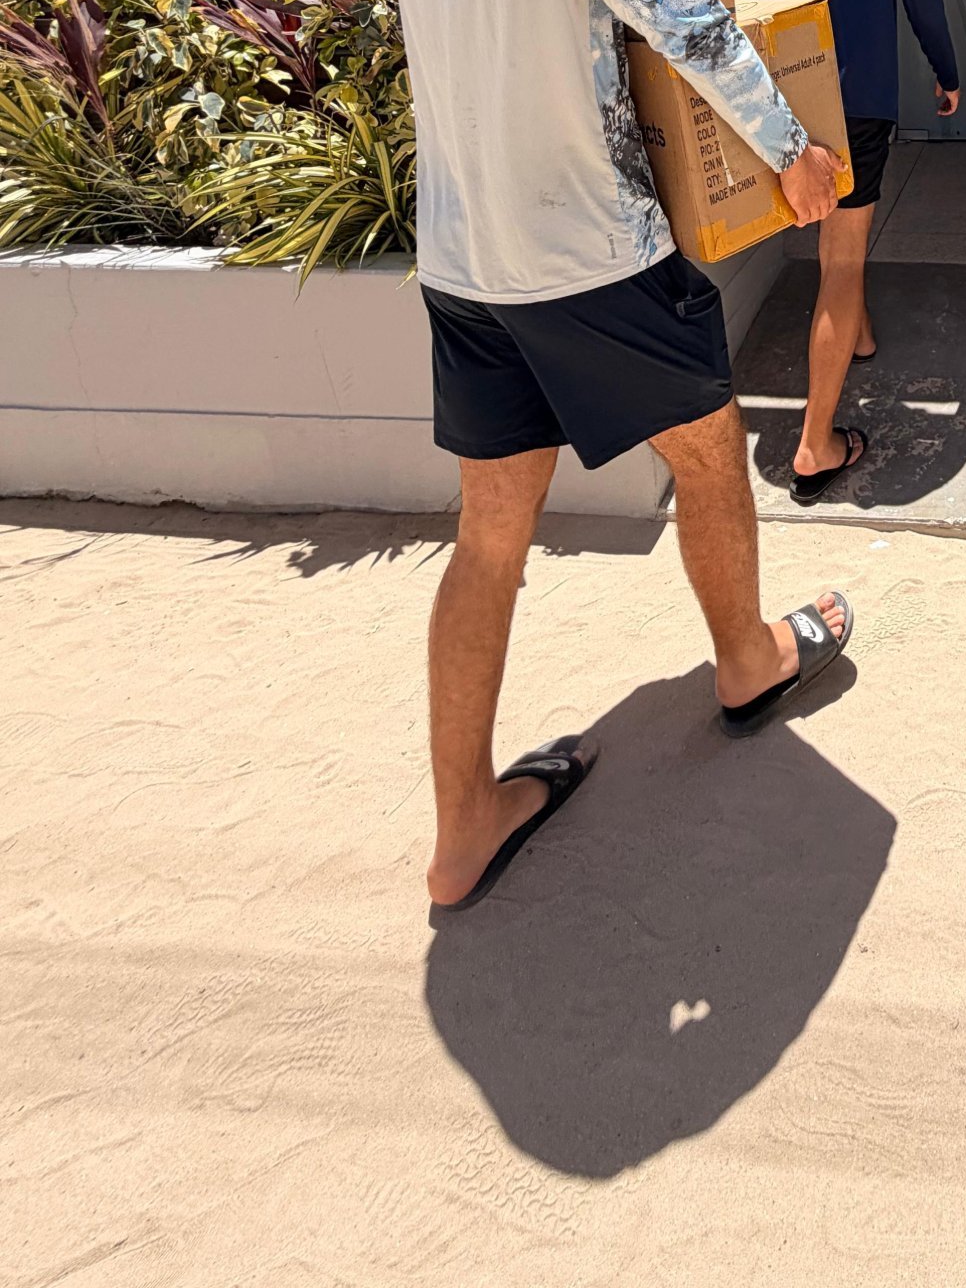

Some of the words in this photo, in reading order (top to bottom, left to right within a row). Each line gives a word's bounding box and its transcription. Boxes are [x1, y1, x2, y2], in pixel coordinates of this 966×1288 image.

[781, 61, 801, 78] Universal
[800, 57, 812, 70] Adult
[709, 187, 729, 205] MADE
[728, 184, 737, 198] IN
[736, 174, 757, 193] CHINA
